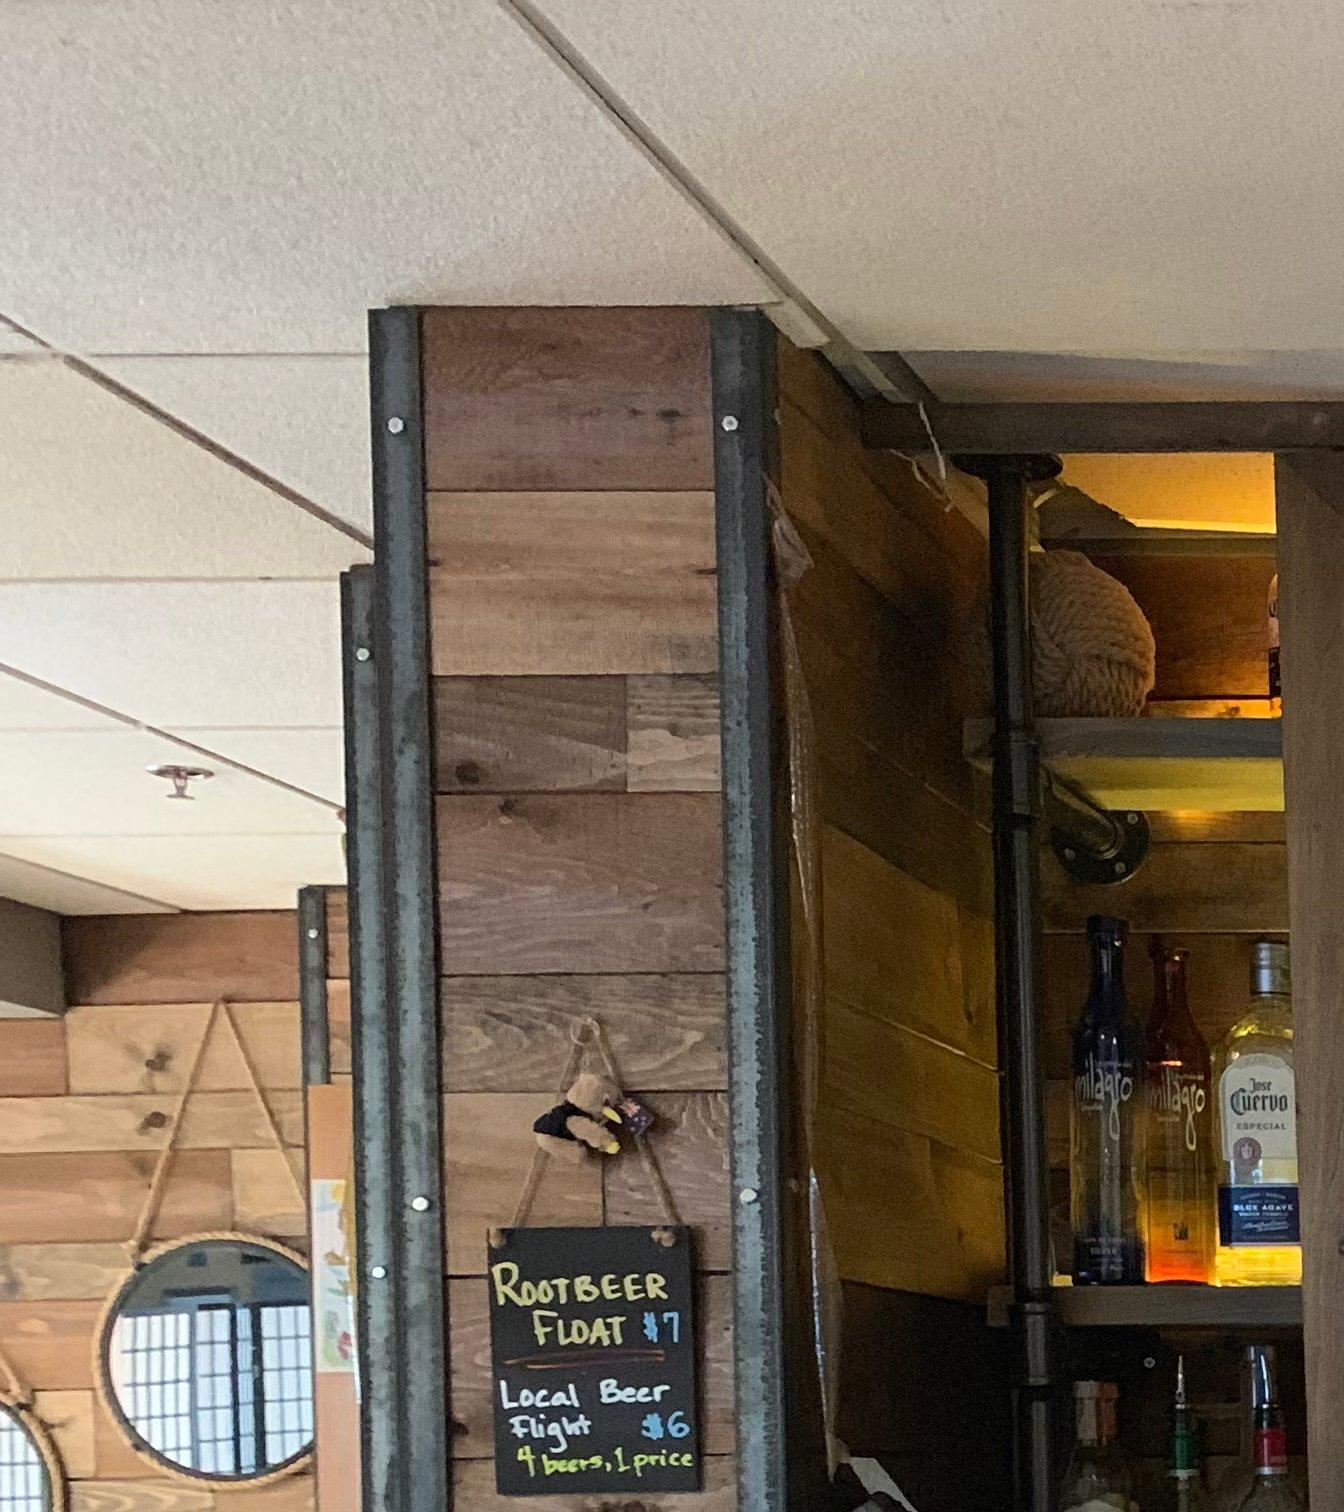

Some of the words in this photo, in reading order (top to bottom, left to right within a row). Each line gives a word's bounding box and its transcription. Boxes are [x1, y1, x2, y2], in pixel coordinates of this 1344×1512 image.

[1076, 1052, 1133, 1141] milagro
[1230, 1088, 1289, 1116] Cuervo
[1250, 1077, 1272, 1094] Jose
[1236, 1122, 1287, 1131] ESPECIAL
[490, 1261, 669, 1308] ROOTBEER
[532, 1308, 628, 1347] FLOAT
[641, 1310, 681, 1345] $7
[499, 1378, 580, 1411] Local
[600, 1378, 671, 1404] Beer
[508, 1415, 593, 1455] Flight
[641, 1409, 690, 1440] $6
[516, 1445, 536, 1478] 4
[632, 1450, 694, 1478] price
